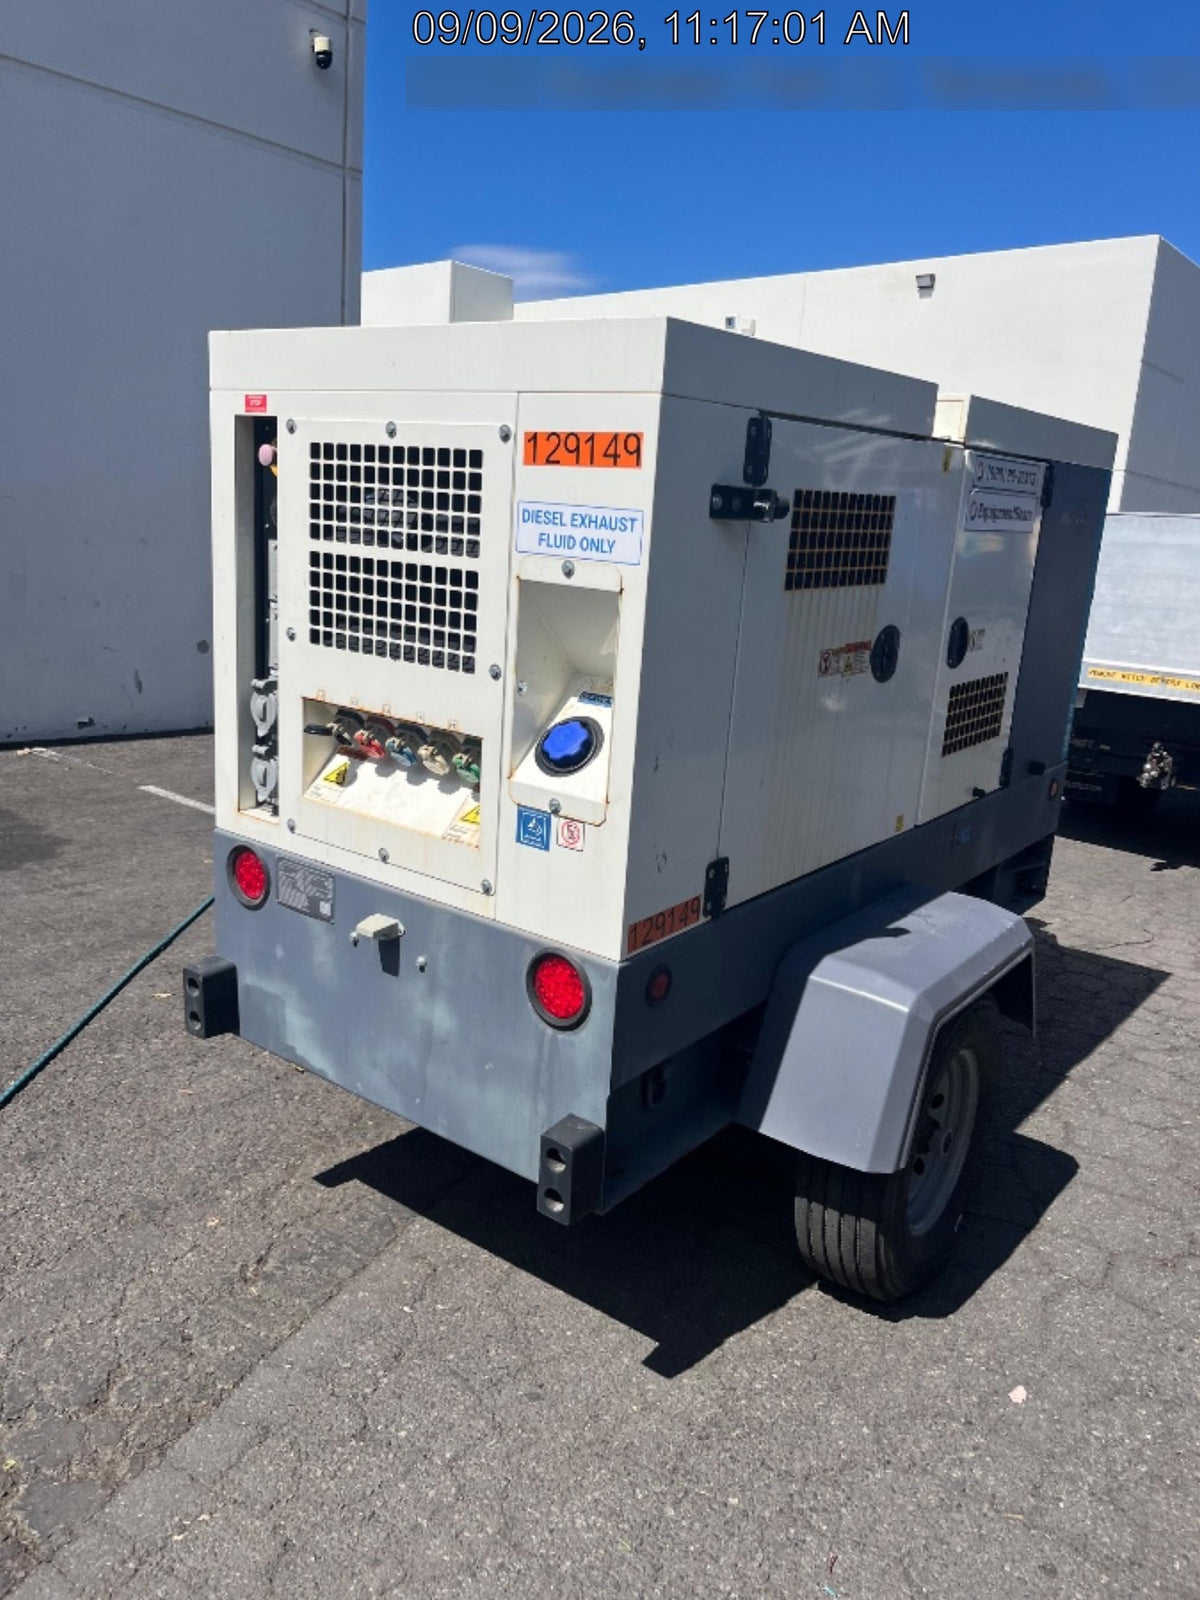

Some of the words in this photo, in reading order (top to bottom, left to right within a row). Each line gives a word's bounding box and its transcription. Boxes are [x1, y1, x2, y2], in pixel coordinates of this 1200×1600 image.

[527, 431, 641, 466] 129149
[522, 508, 567, 527] DIESEL
[570, 513, 638, 533] EXHAUST
[538, 532, 576, 550] FLUID
[580, 536, 616, 554] ONLY
[629, 896, 701, 948] 129149
